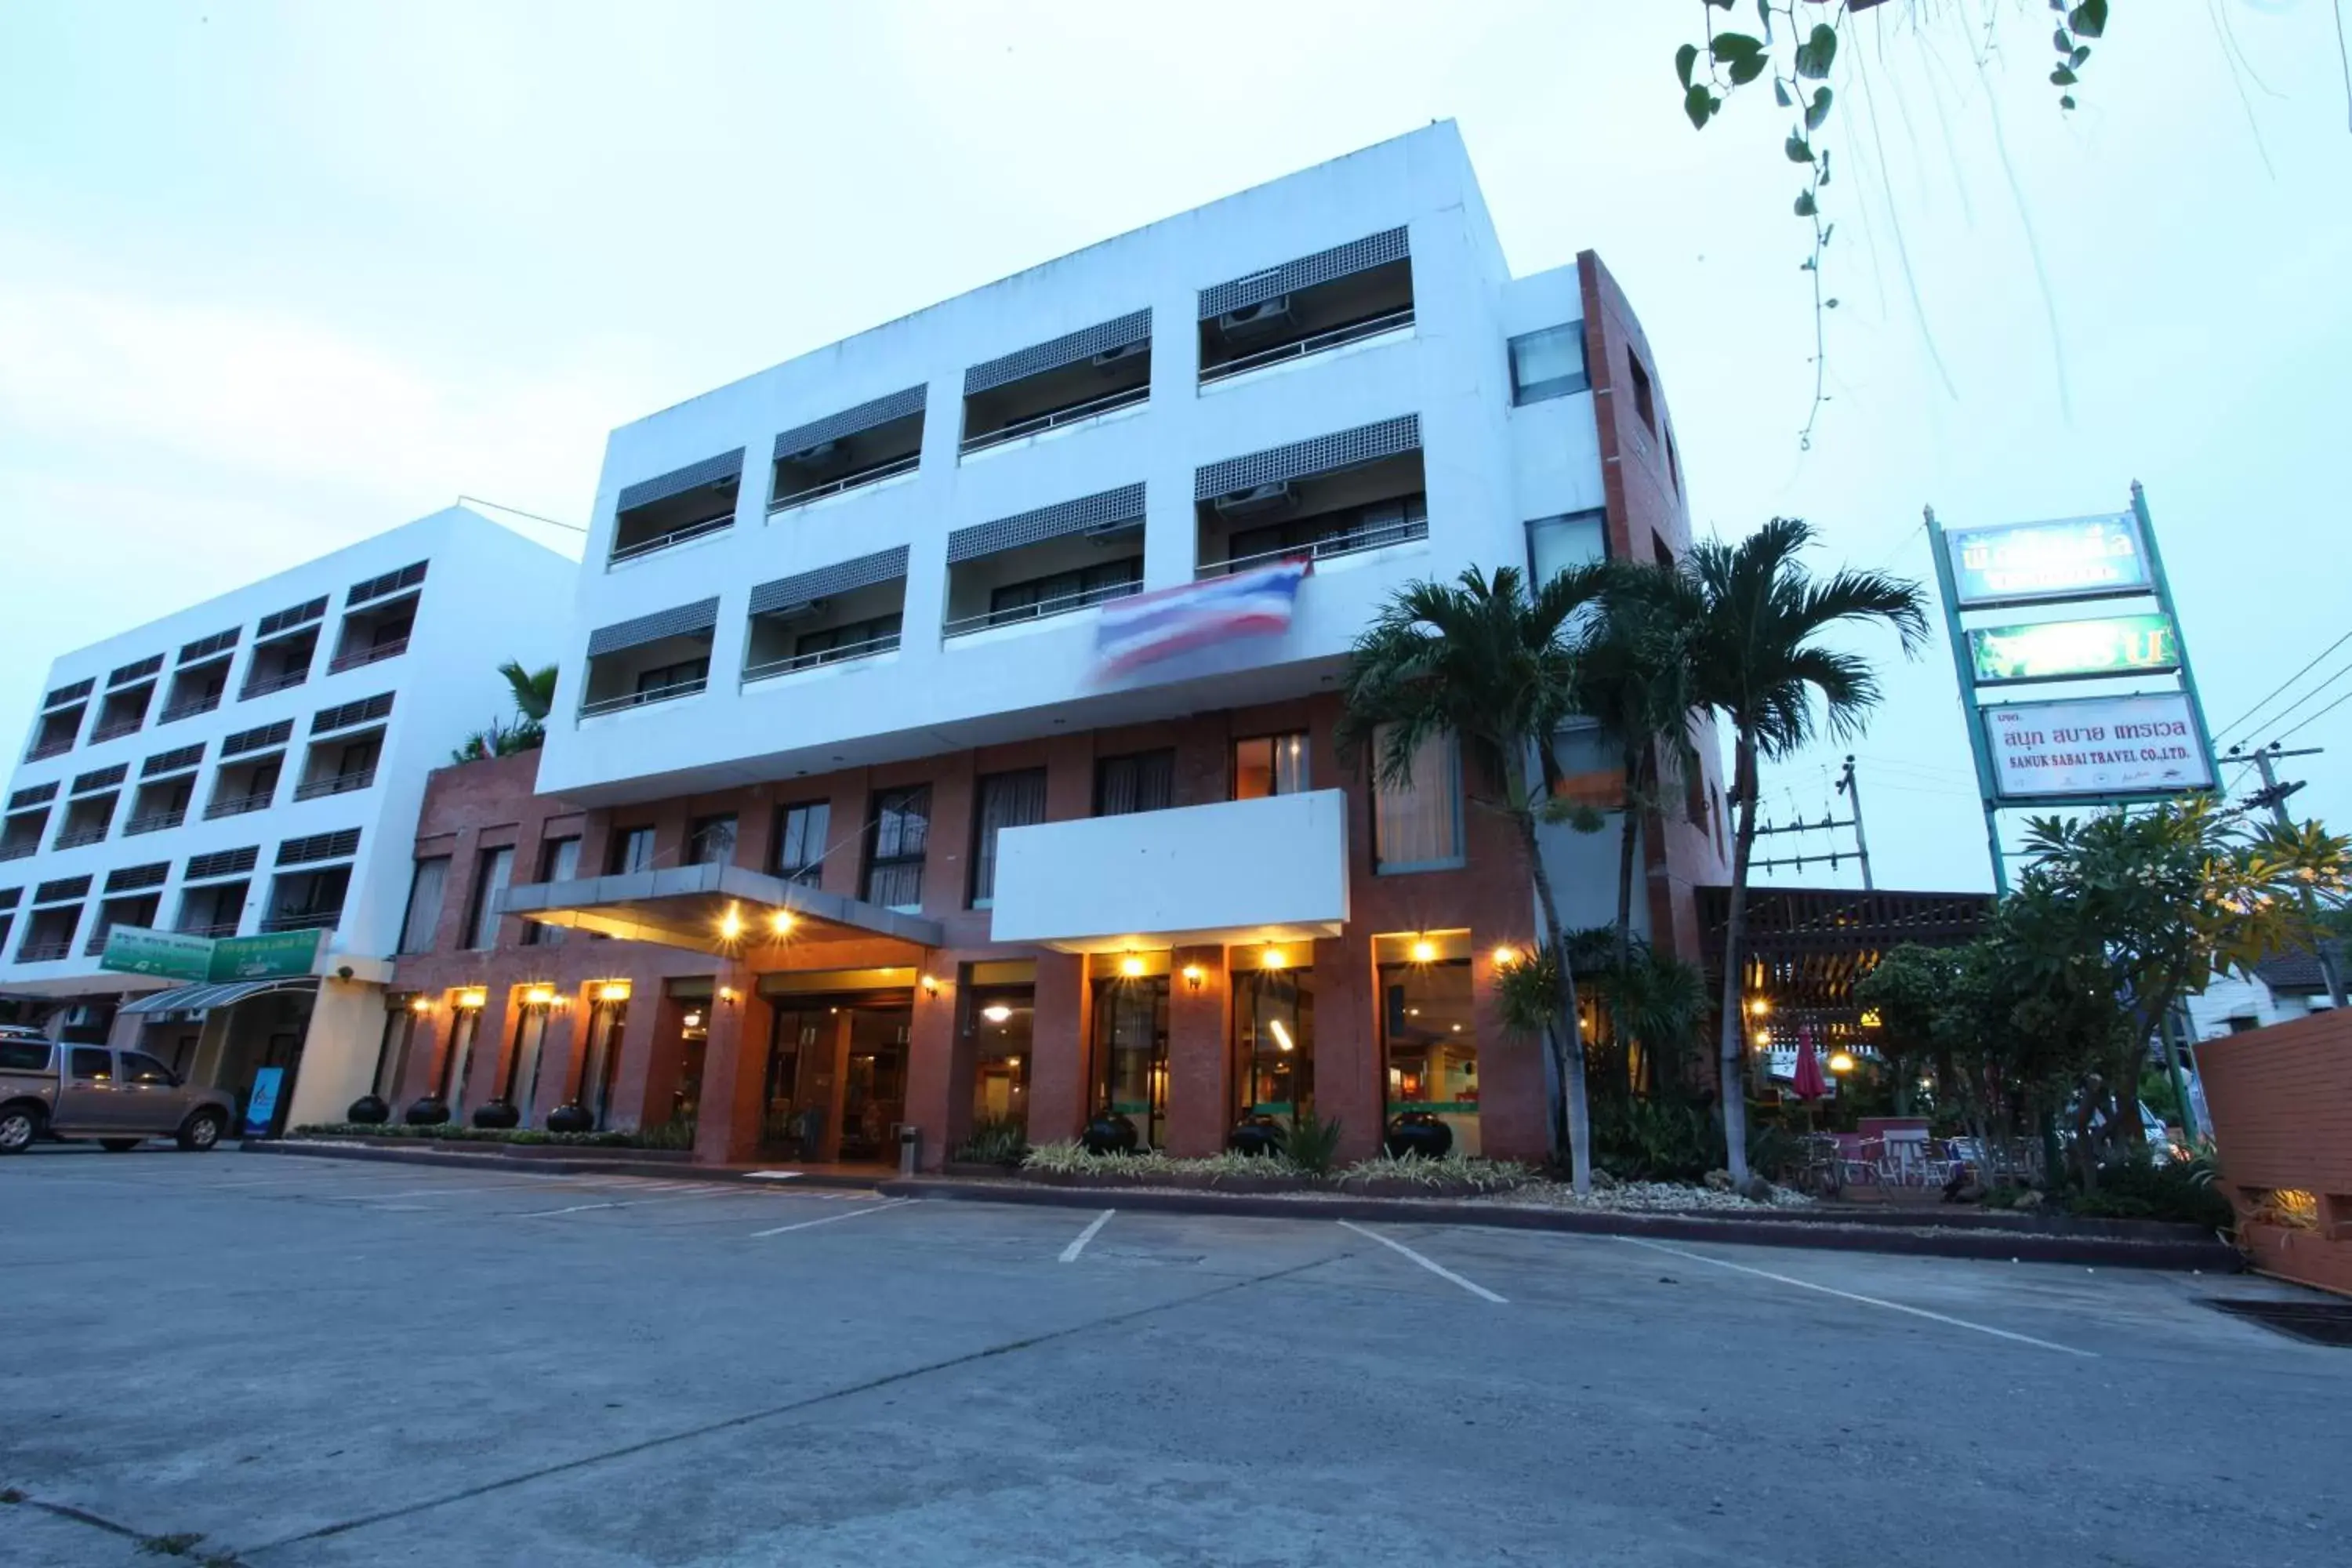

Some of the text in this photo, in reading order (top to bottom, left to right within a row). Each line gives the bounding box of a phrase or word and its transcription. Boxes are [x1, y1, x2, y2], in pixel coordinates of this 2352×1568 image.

[2004, 731, 2045, 750] สนุก
[2053, 727, 2105, 745] สบาย
[2009, 755, 2049, 768] SANUK
[2053, 753, 2087, 766] SABAI
[2090, 750, 2136, 764] TRAVEL
